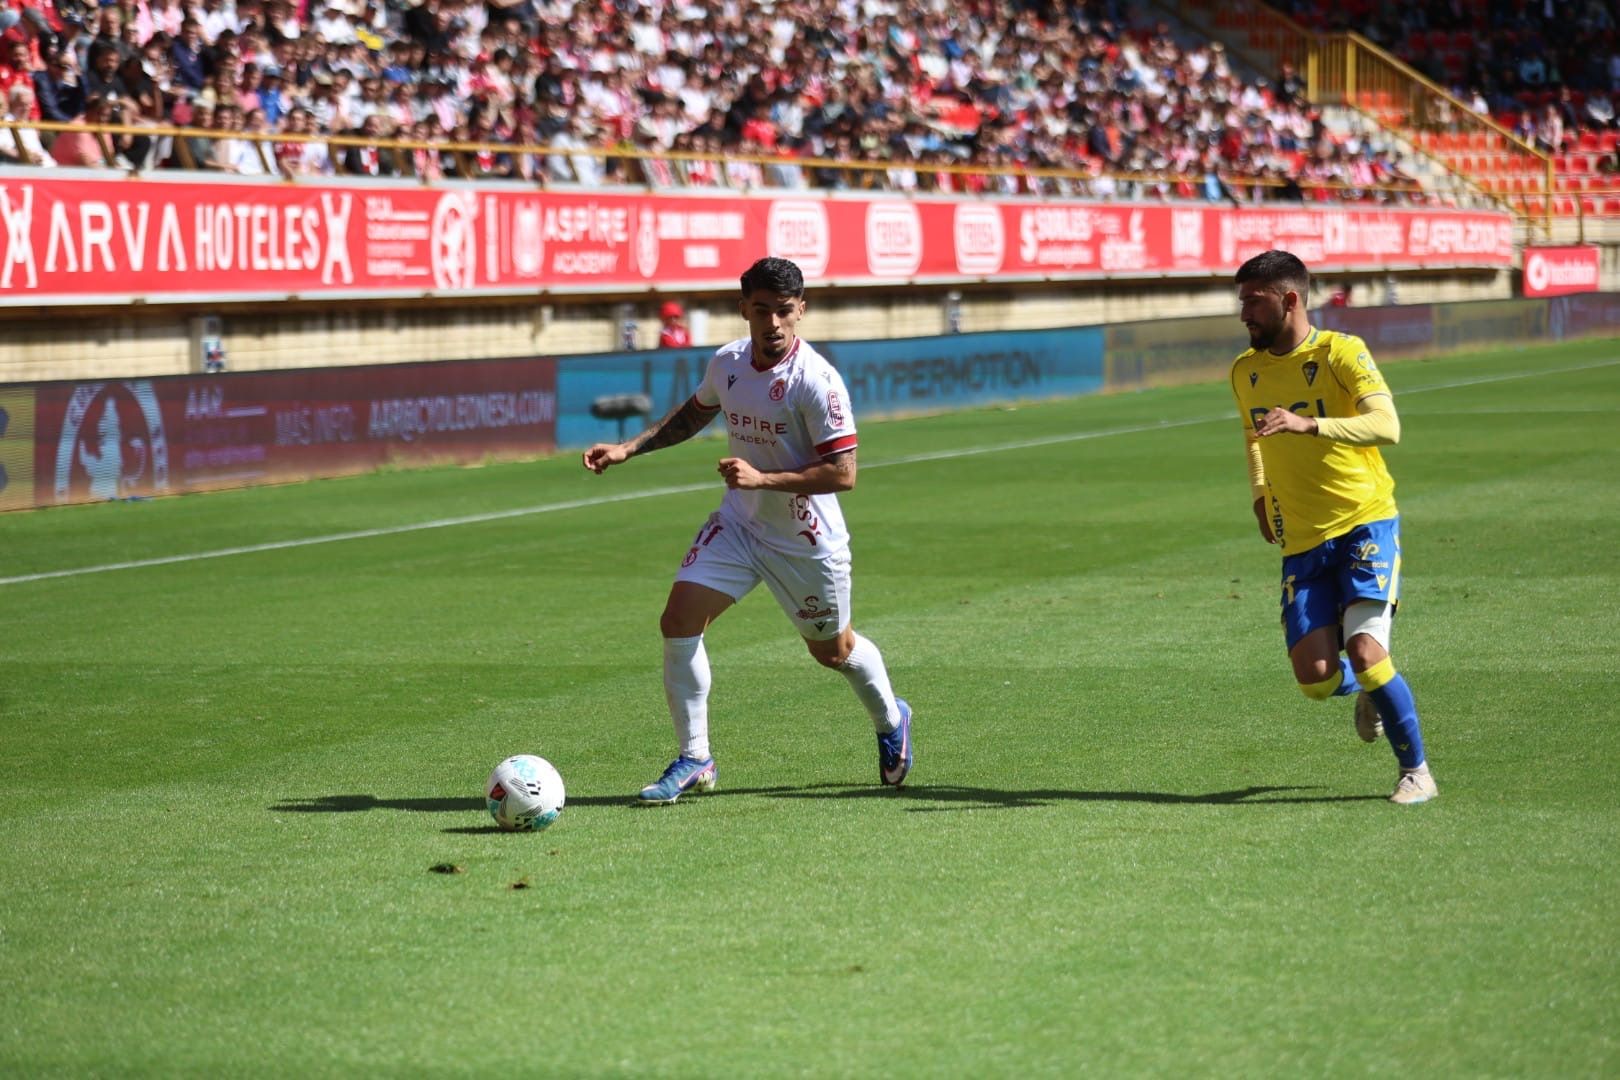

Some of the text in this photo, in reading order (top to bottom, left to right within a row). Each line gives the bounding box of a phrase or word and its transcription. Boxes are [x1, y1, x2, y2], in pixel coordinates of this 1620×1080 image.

[44, 200, 321, 273] ARVA HOTELES
[543, 202, 629, 247] ASPIRE
